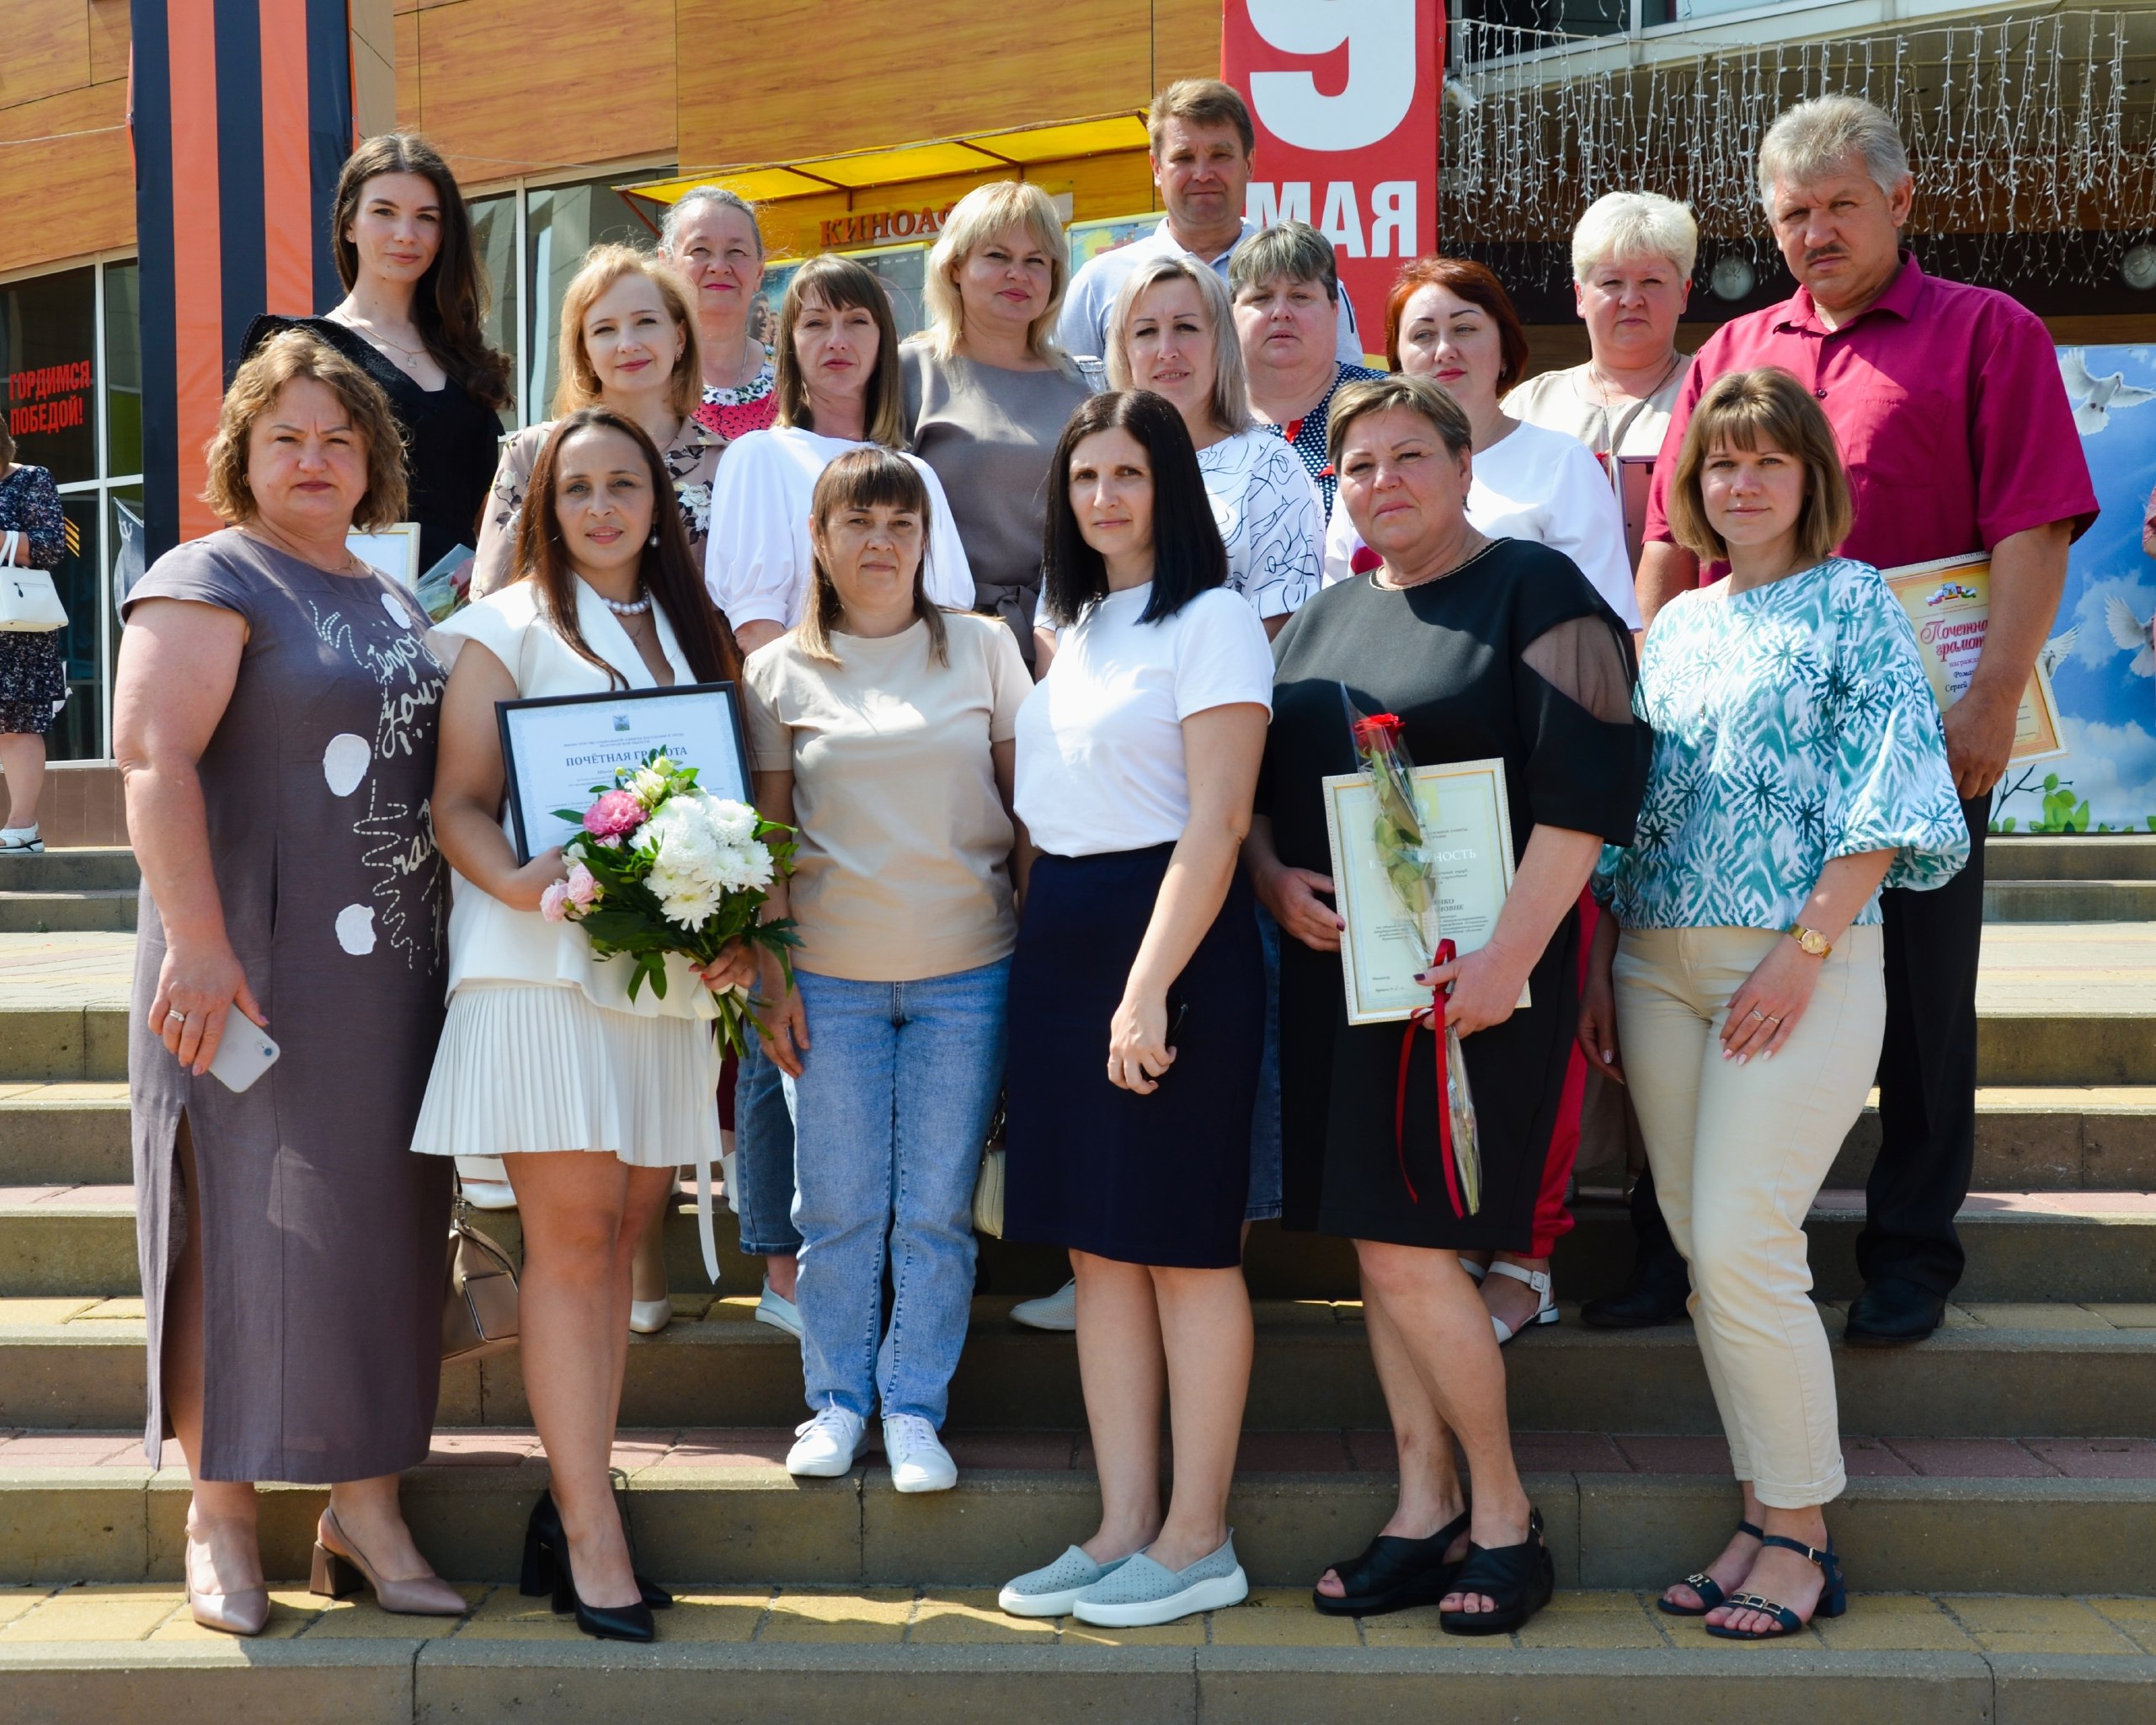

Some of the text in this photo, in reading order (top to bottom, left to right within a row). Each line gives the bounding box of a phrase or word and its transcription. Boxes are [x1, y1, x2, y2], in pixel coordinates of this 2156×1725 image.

[1246, 0, 1417, 152] 9
[1246, 180, 1417, 258] МАЯ
[9, 360, 90, 401] ГОРДИМСЯ
[10, 395, 83, 436] ПОБЕДОЙ!
[566, 746, 688, 766] ПОЧЁТНАЯ ГРОТА
